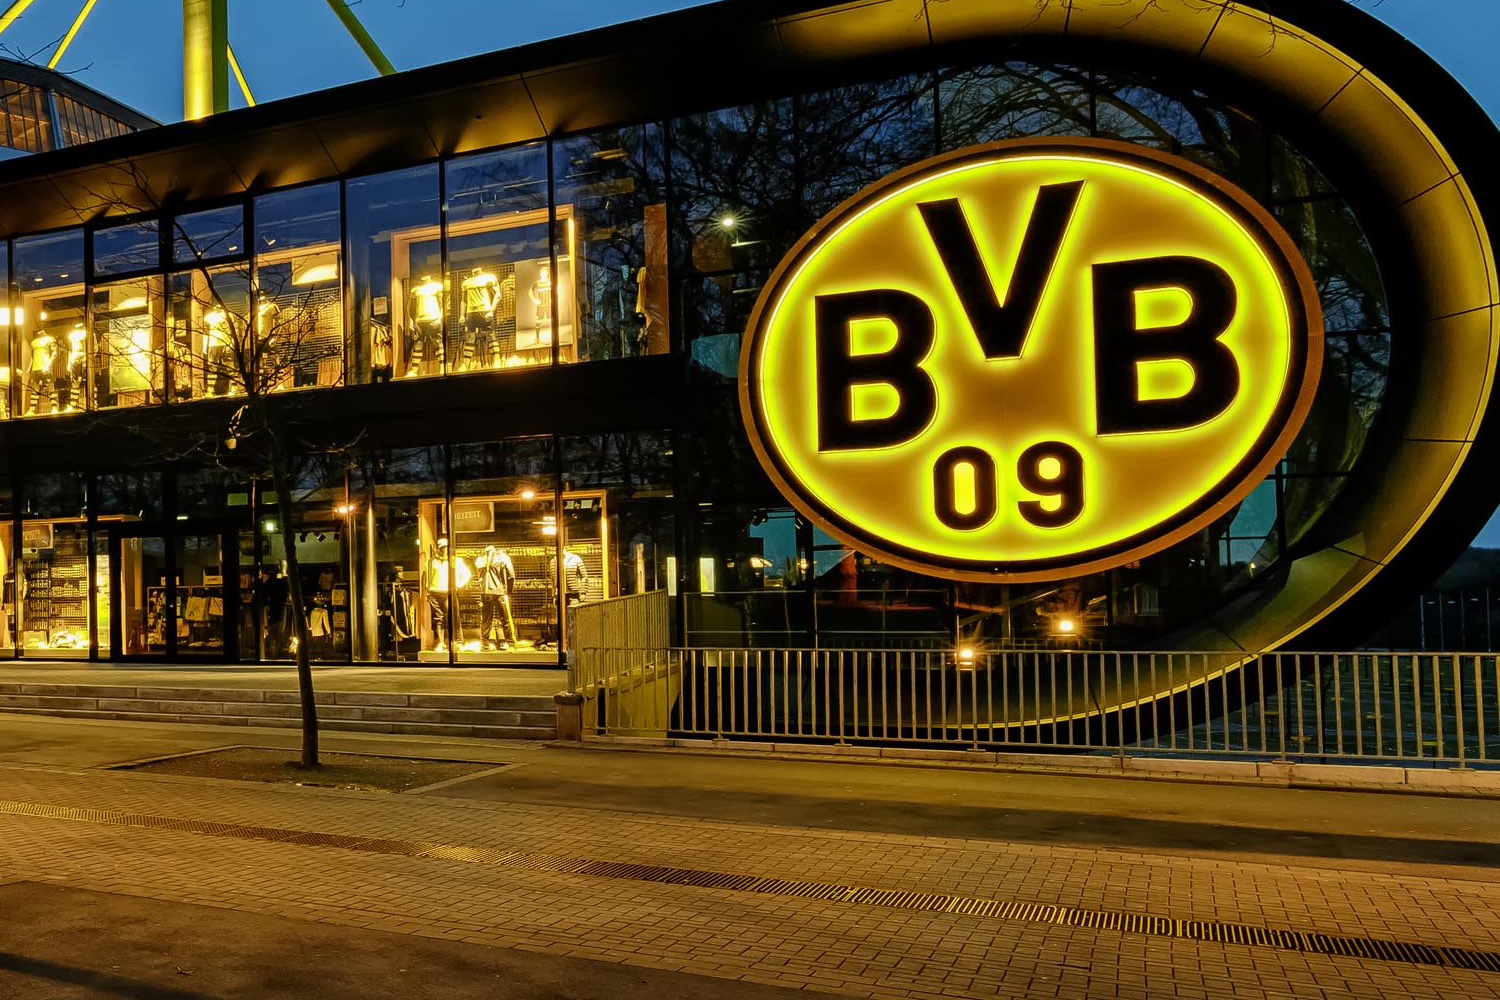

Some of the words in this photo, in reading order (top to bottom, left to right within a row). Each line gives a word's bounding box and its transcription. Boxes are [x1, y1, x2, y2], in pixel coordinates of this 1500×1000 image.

[814, 179, 1240, 453] BVB
[454, 510, 481, 519] EIZEIT
[933, 440, 1086, 531] 09
